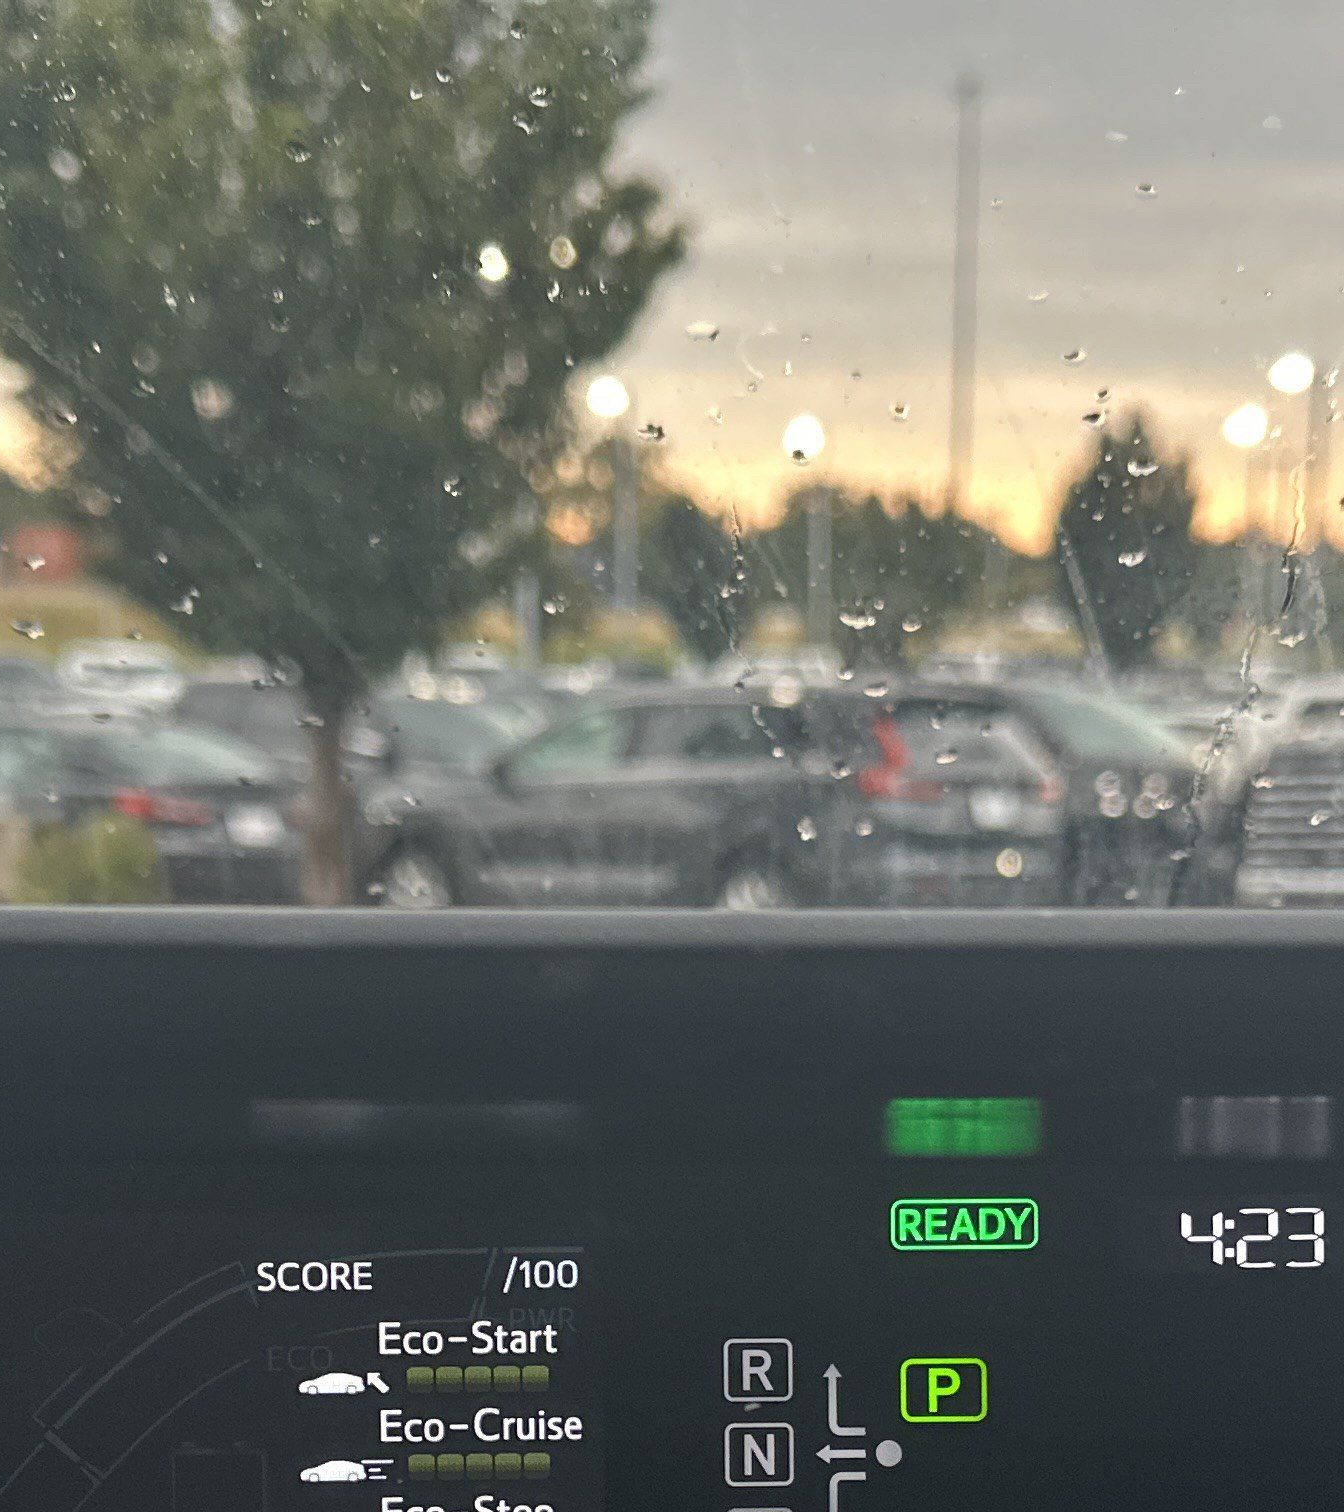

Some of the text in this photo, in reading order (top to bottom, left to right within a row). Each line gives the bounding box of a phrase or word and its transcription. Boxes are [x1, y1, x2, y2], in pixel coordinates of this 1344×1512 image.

[899, 1207, 1032, 1241] READY
[1181, 1208, 1324, 1268] 4:23
[257, 1257, 578, 1293] SCORE /100
[379, 1321, 557, 1354] Eco-Start
[742, 1350, 773, 1390] R
[928, 1368, 960, 1412] P
[380, 1408, 582, 1442] Eco-Cruise
[744, 1434, 775, 1475] N
